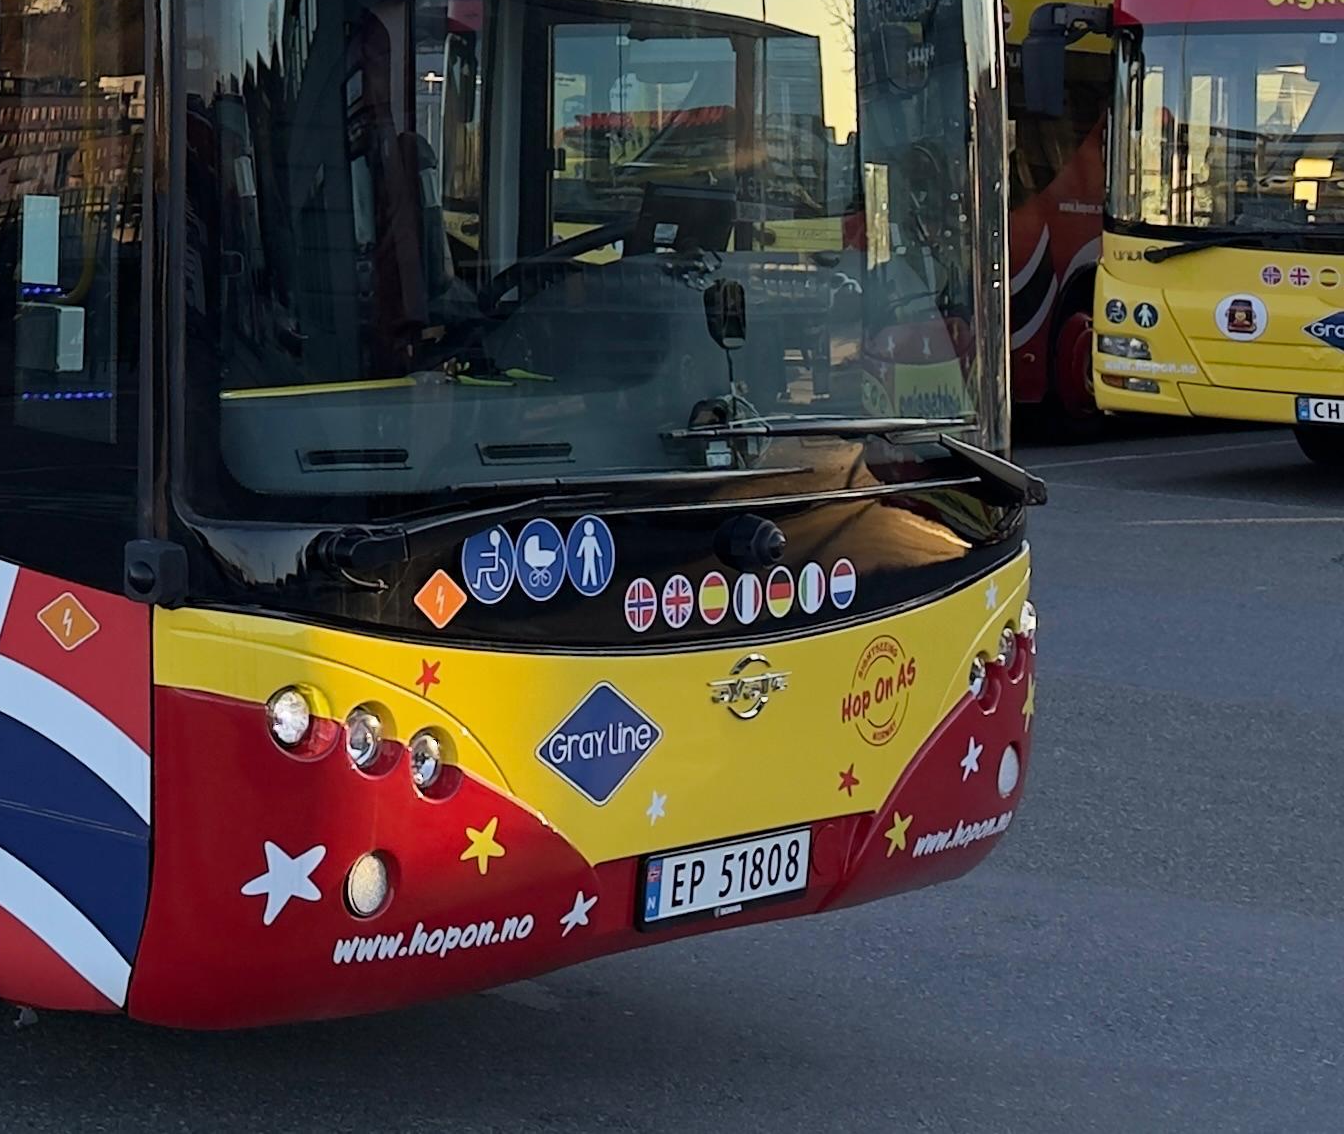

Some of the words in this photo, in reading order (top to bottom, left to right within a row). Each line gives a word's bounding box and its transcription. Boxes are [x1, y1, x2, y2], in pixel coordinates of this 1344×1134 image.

[1313, 402, 1340, 419] CH
[842, 691, 871, 723] Hop
[875, 676, 894, 704] On
[897, 657, 916, 692] AS
[671, 859, 705, 907] EP
[719, 839, 800, 898] 51808
[646, 896, 656, 910] N
[332, 913, 535, 965] www.hopon.no
